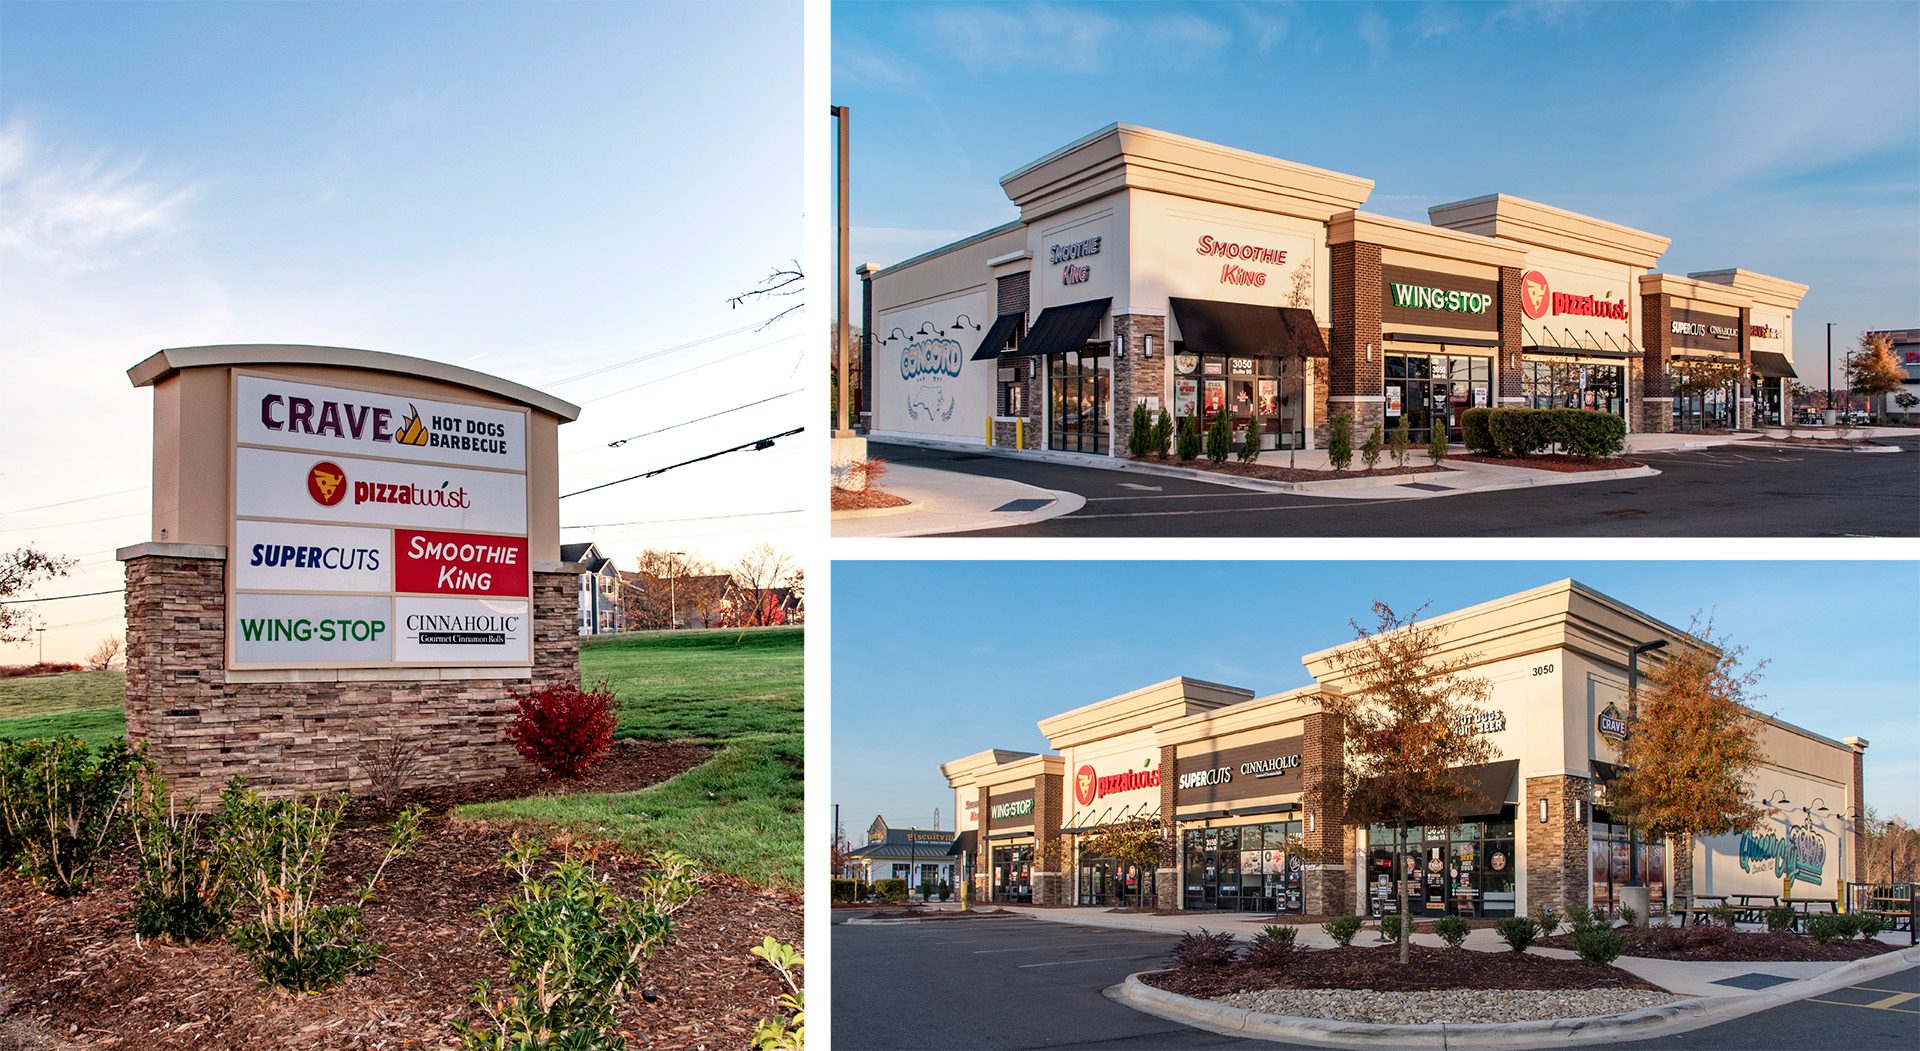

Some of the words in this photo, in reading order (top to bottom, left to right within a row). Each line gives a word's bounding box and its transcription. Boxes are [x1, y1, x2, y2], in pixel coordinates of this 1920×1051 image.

[1049, 236, 1102, 264] SMOOTHIE
[1197, 234, 1288, 265] SMOOTHIE
[1671, 320, 1706, 337] SUPERCUTS
[901, 338, 962, 380] CONCORD
[1232, 359, 1253, 369] 3050
[261, 393, 393, 443] CRAVE
[432, 415, 462, 434] HOT
[466, 419, 505, 437] DOGS
[430, 432, 507, 454] BARBECUE
[354, 480, 471, 509] pizzatwist
[250, 543, 380, 571] SUPERCUTS
[407, 535, 518, 565] SMOOTHIE
[420, 633, 452, 643] Gourmet
[452, 634, 488, 643] Cinnamon
[488, 634, 504, 643] Rolls
[1532, 664, 1555, 677] 3050
[1601, 717, 1626, 735] CRAVE
[1179, 766, 1233, 790] SUPERCUTS
[1240, 754, 1301, 778] CINNAHOLIC
